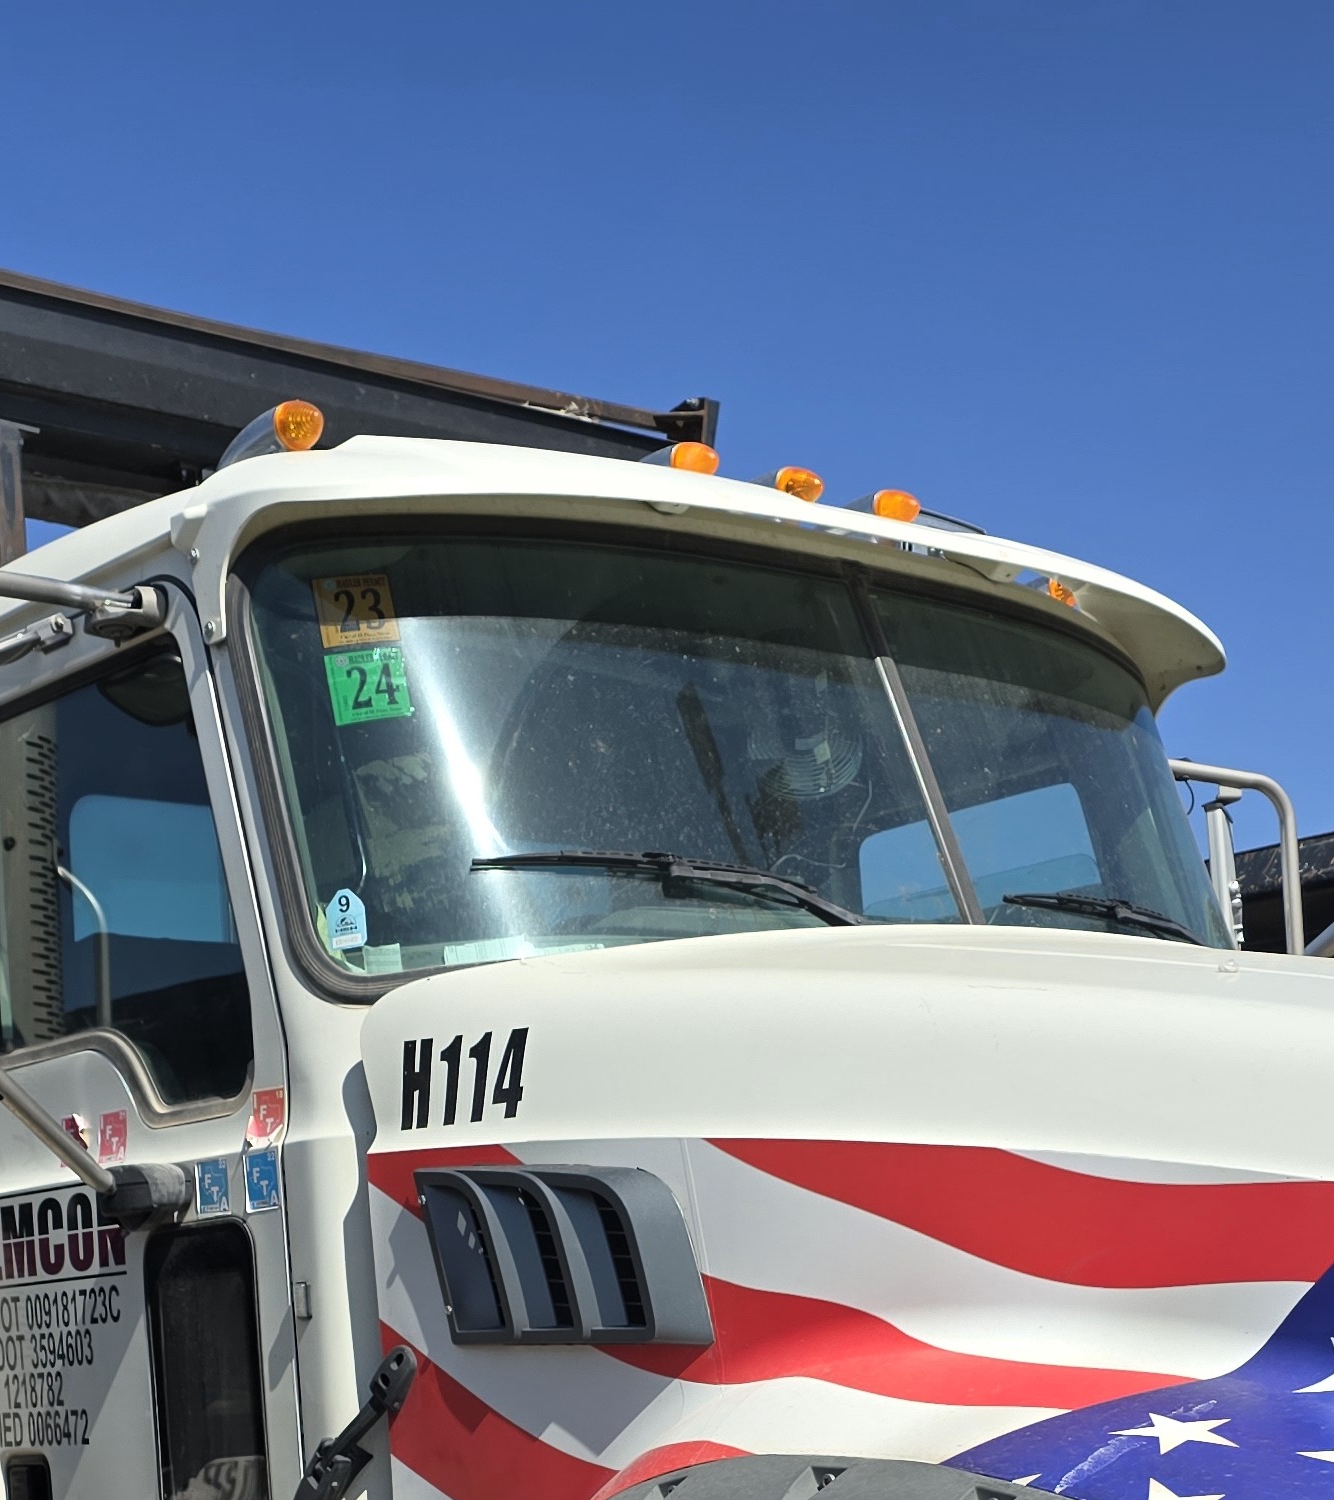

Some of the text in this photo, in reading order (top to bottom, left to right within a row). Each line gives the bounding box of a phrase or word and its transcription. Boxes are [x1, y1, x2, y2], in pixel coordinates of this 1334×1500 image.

[334, 588, 385, 632] 23
[346, 662, 399, 710] 24
[338, 895, 350, 913] 9
[401, 1027, 529, 1131] H114
[25, 1285, 121, 1330] 009181723C
[30, 1328, 94, 1369] 3594603
[4, 1371, 65, 1409] 1218782
[27, 1408, 90, 1447] 0066472
